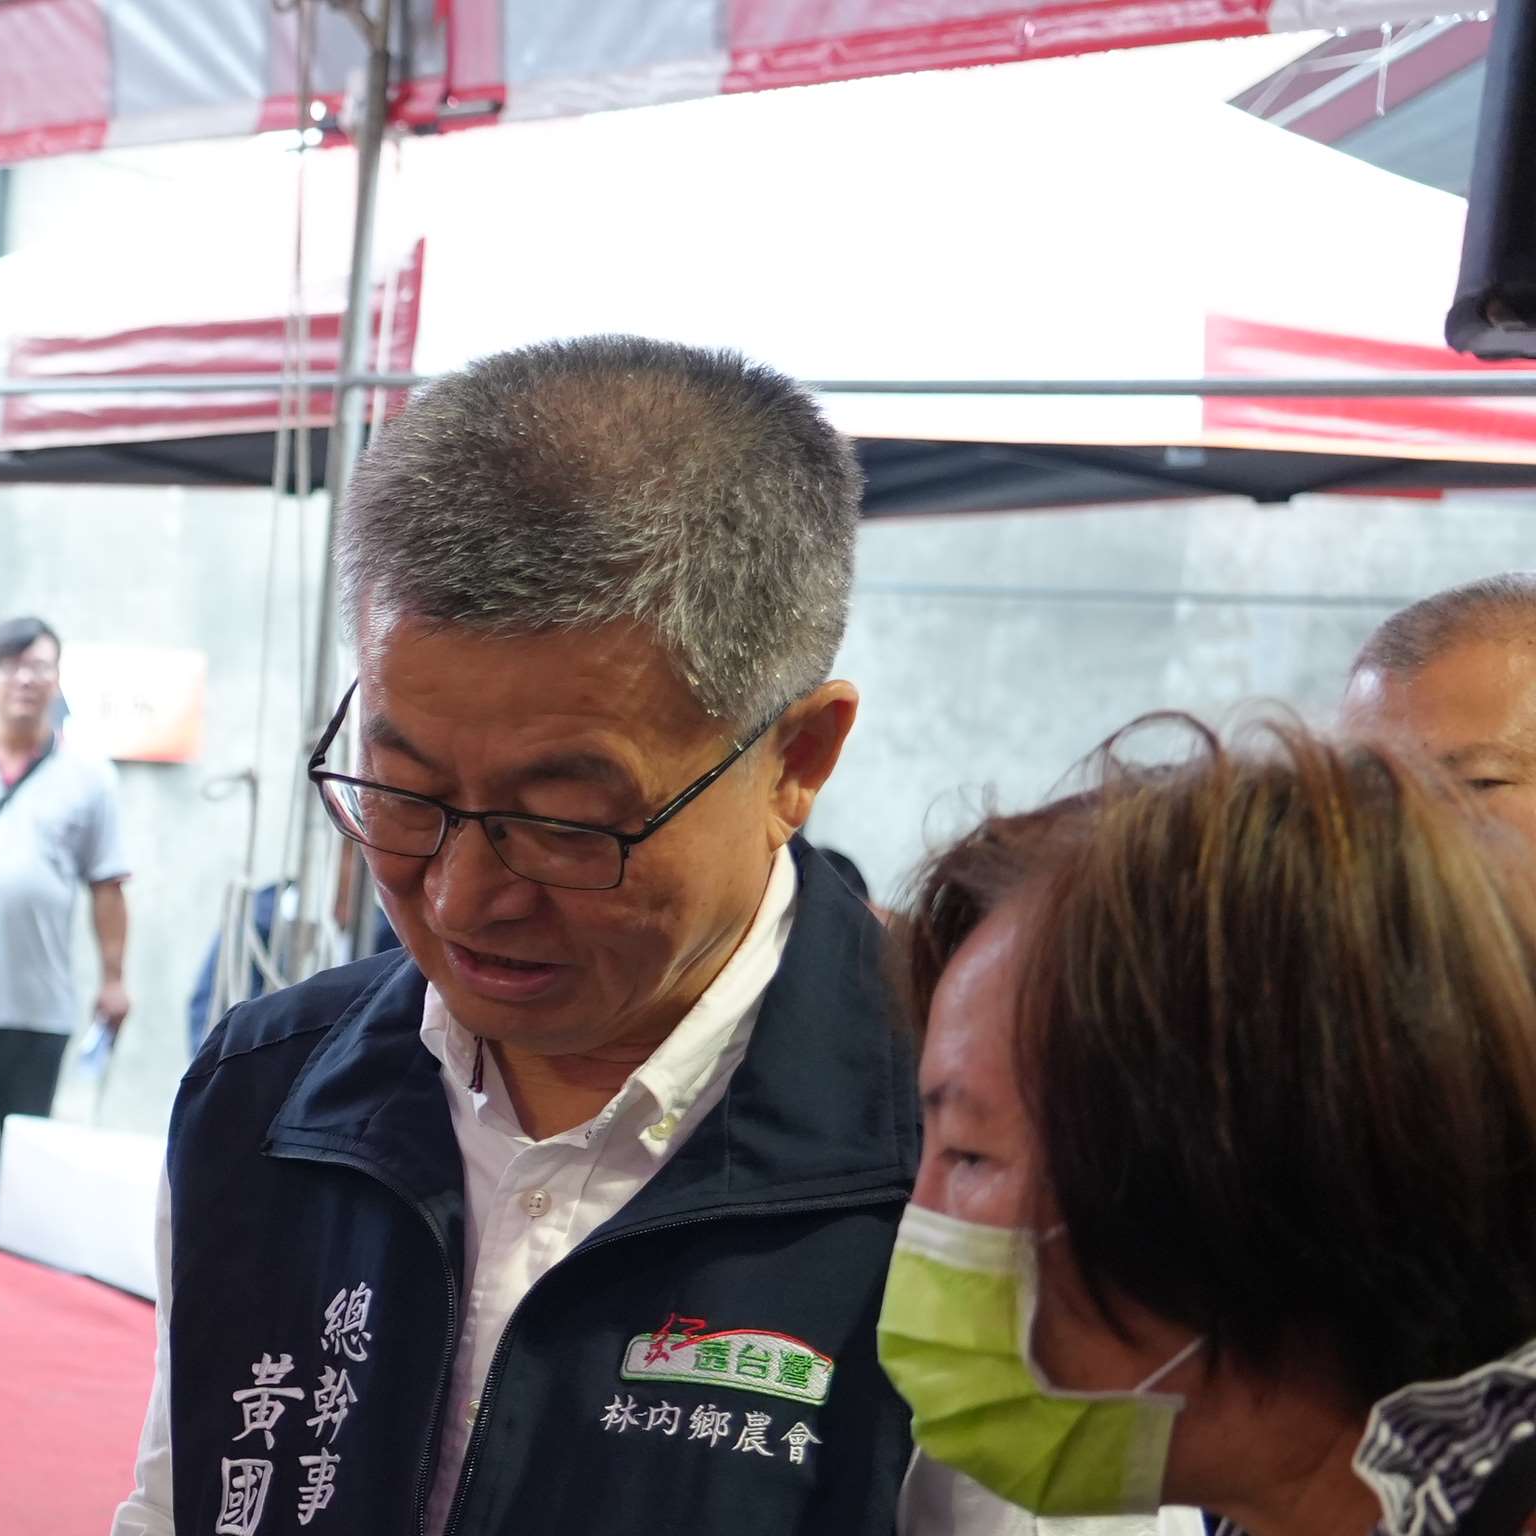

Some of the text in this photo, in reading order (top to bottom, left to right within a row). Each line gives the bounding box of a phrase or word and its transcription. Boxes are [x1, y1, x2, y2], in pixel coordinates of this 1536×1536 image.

[298, 1281, 374, 1527] 總幹事
[599, 1394, 824, 1465] 林內鄉農會
